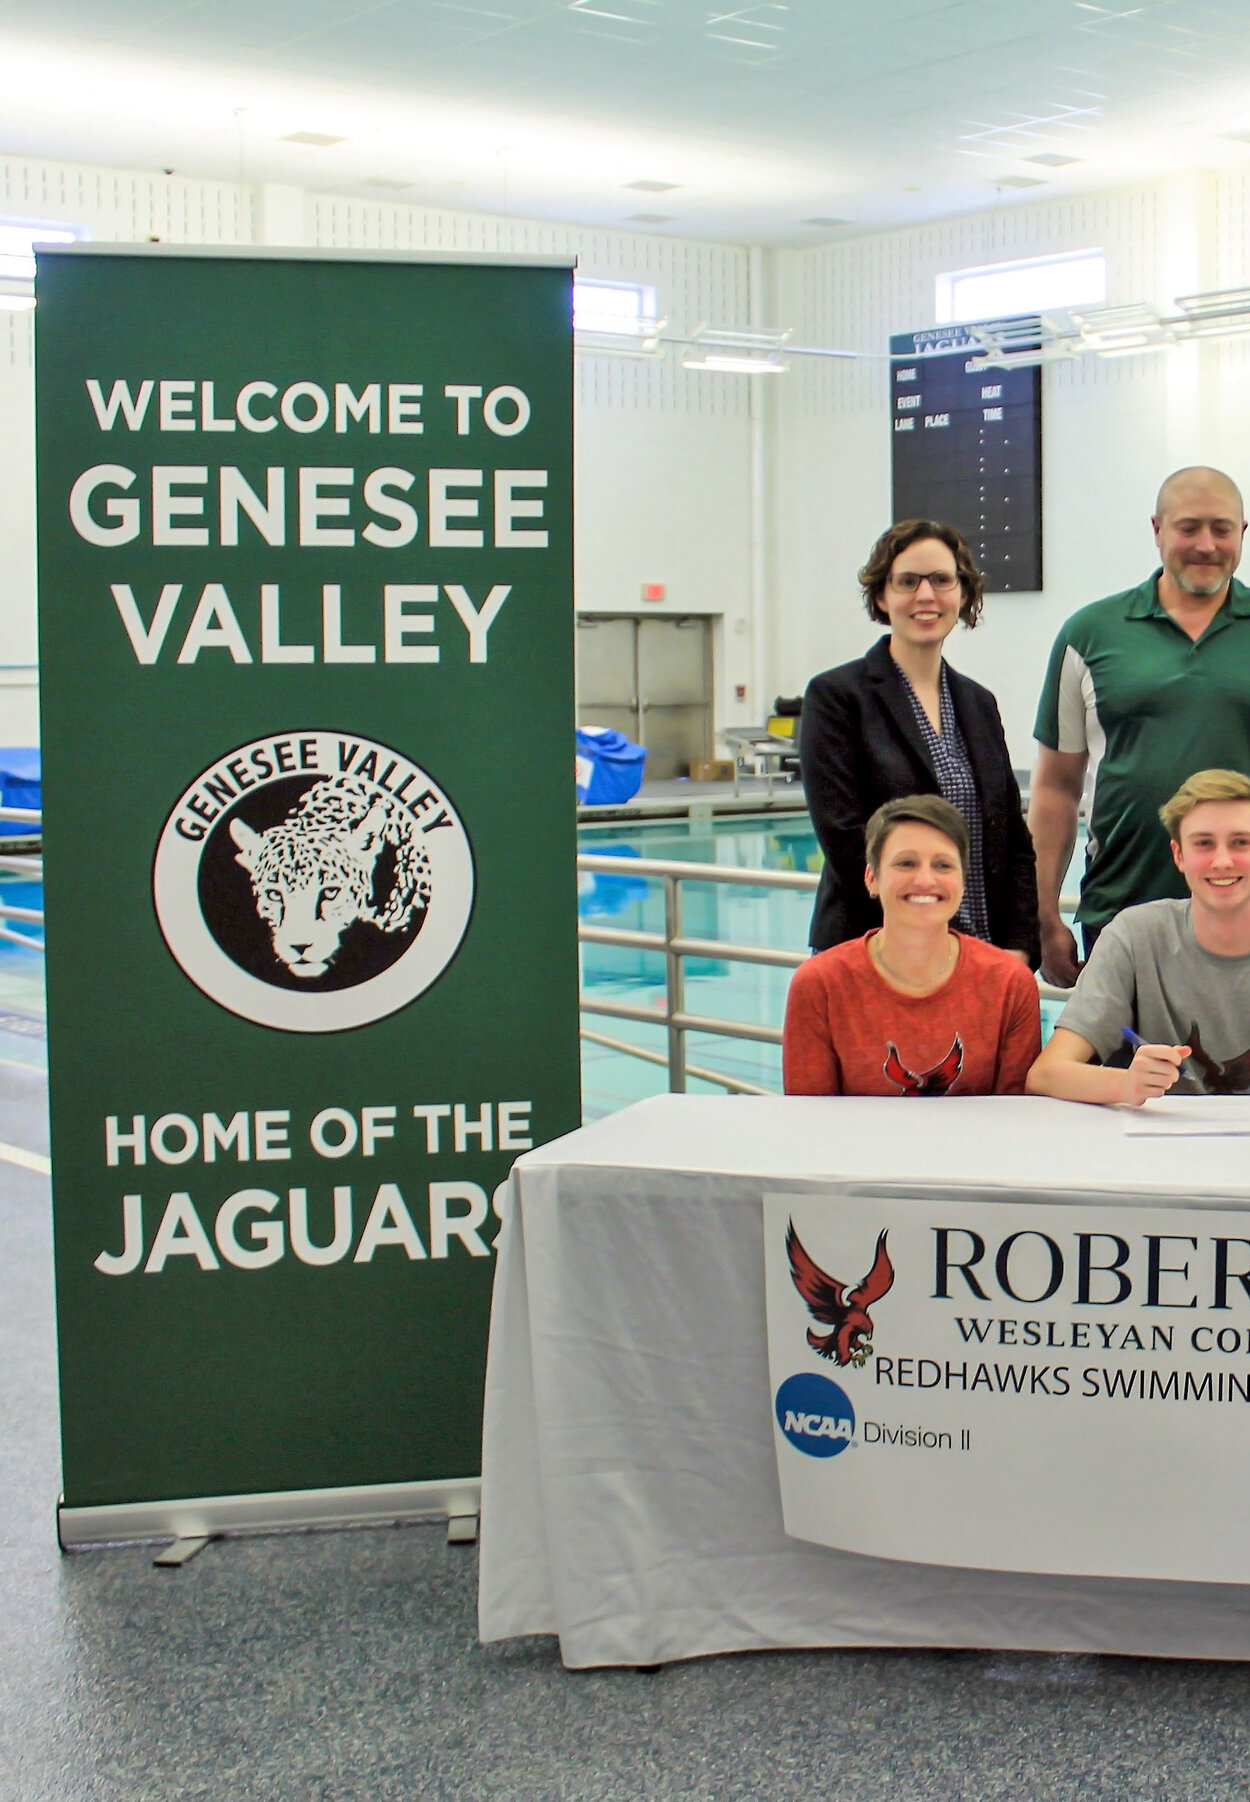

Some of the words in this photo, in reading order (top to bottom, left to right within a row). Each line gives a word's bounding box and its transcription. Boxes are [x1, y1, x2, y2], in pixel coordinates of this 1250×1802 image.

[912, 327, 962, 343] GENESEE
[85, 379, 424, 435] WELCOME
[444, 384, 531, 437] TO
[897, 394, 922, 410] EVENT
[981, 384, 1002, 400] HEAT
[894, 416, 915, 432] LANE
[924, 412, 950, 428] PLACE
[982, 406, 1003, 422] TIME
[69, 463, 549, 548] GENESEE
[110, 582, 512, 664] VALLEY
[175, 738, 319, 842] GENESEE
[338, 740, 454, 835] VALLEY
[105, 1109, 292, 1166] HOME
[309, 1106, 397, 1159] OF
[413, 1100, 533, 1154] THE
[93, 1179, 508, 1276] JAGUAR
[954, 1317, 1175, 1352] WESLEYAN
[875, 1356, 1071, 1396] REDHAWKS
[784, 1410, 852, 1441] NCAA
[864, 1421, 952, 1449] Division
